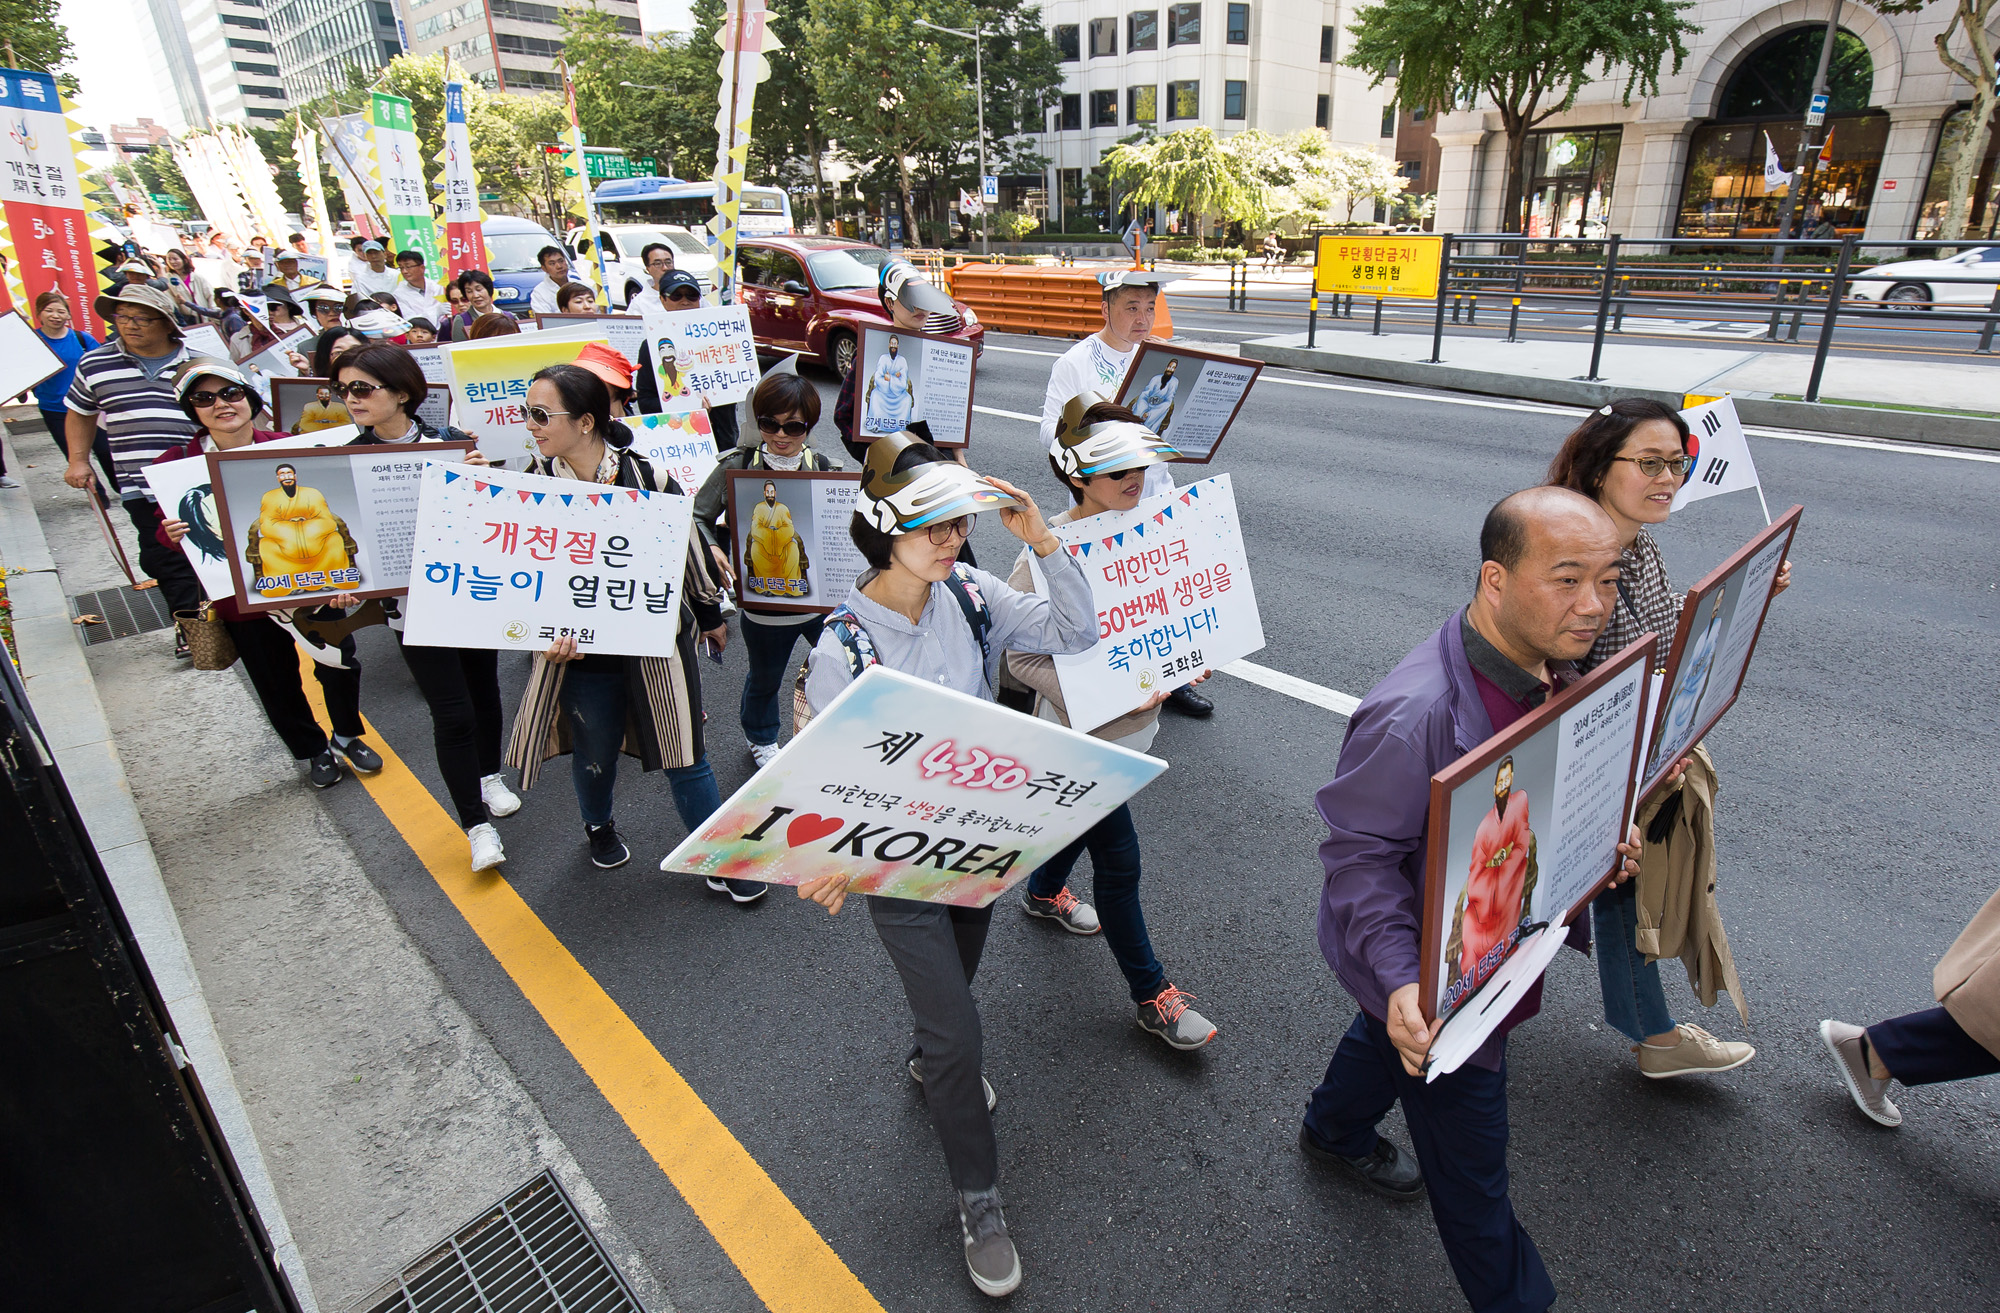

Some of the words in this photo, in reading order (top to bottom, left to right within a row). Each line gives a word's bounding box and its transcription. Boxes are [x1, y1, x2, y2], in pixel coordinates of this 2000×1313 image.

[761, 198, 776, 209] 270
[63, 217, 78, 247] Widely
[422, 227, 435, 258] HAPPY
[69, 248, 85, 279] Benefit
[1338, 246, 1417, 262] 무단횡단금지!
[1351, 264, 1401, 281] 생명위협
[684, 318, 747, 338] 4350번째
[687, 340, 754, 365] "개천절"을
[689, 368, 758, 393] 축하합니다.
[865, 416, 882, 428] 27세
[883, 417, 897, 429] 단군
[649, 440, 713, 463] 이화세계
[371, 464, 392, 473] 40세
[394, 463, 412, 472] 단군
[826, 488, 837, 496] 5세
[838, 488, 851, 497] 단군
[482, 521, 634, 569] 개천절은
[1102, 538, 1190, 589] 대한민국
[256, 573, 292, 591] 40세
[294, 571, 326, 588] 단군
[329, 567, 361, 584] 달음
[425, 561, 544, 603] 하늘이
[568, 575, 674, 614] 열린날
[749, 576, 765, 590] 5세
[766, 577, 786, 591] 단군
[788, 578, 808, 593] 구을
[1172, 562, 1233, 607] 생일을
[538, 625, 595, 645] 국학원
[1107, 606, 1220, 673] 축하합니다!
[1161, 648, 1204, 680] 국학원
[1573, 712, 1590, 737] 20세
[1591, 702, 1605, 723] 단군
[863, 730, 925, 766] 제
[820, 783, 902, 812] 대한민국
[903, 799, 958, 825] 생일을
[957, 808, 1044, 839] 축하합니다!
[740, 805, 795, 842] I
[827, 821, 1022, 879] KOREA
[1442, 965, 1476, 1013] 20세
[1478, 938, 1505, 981] 단군
